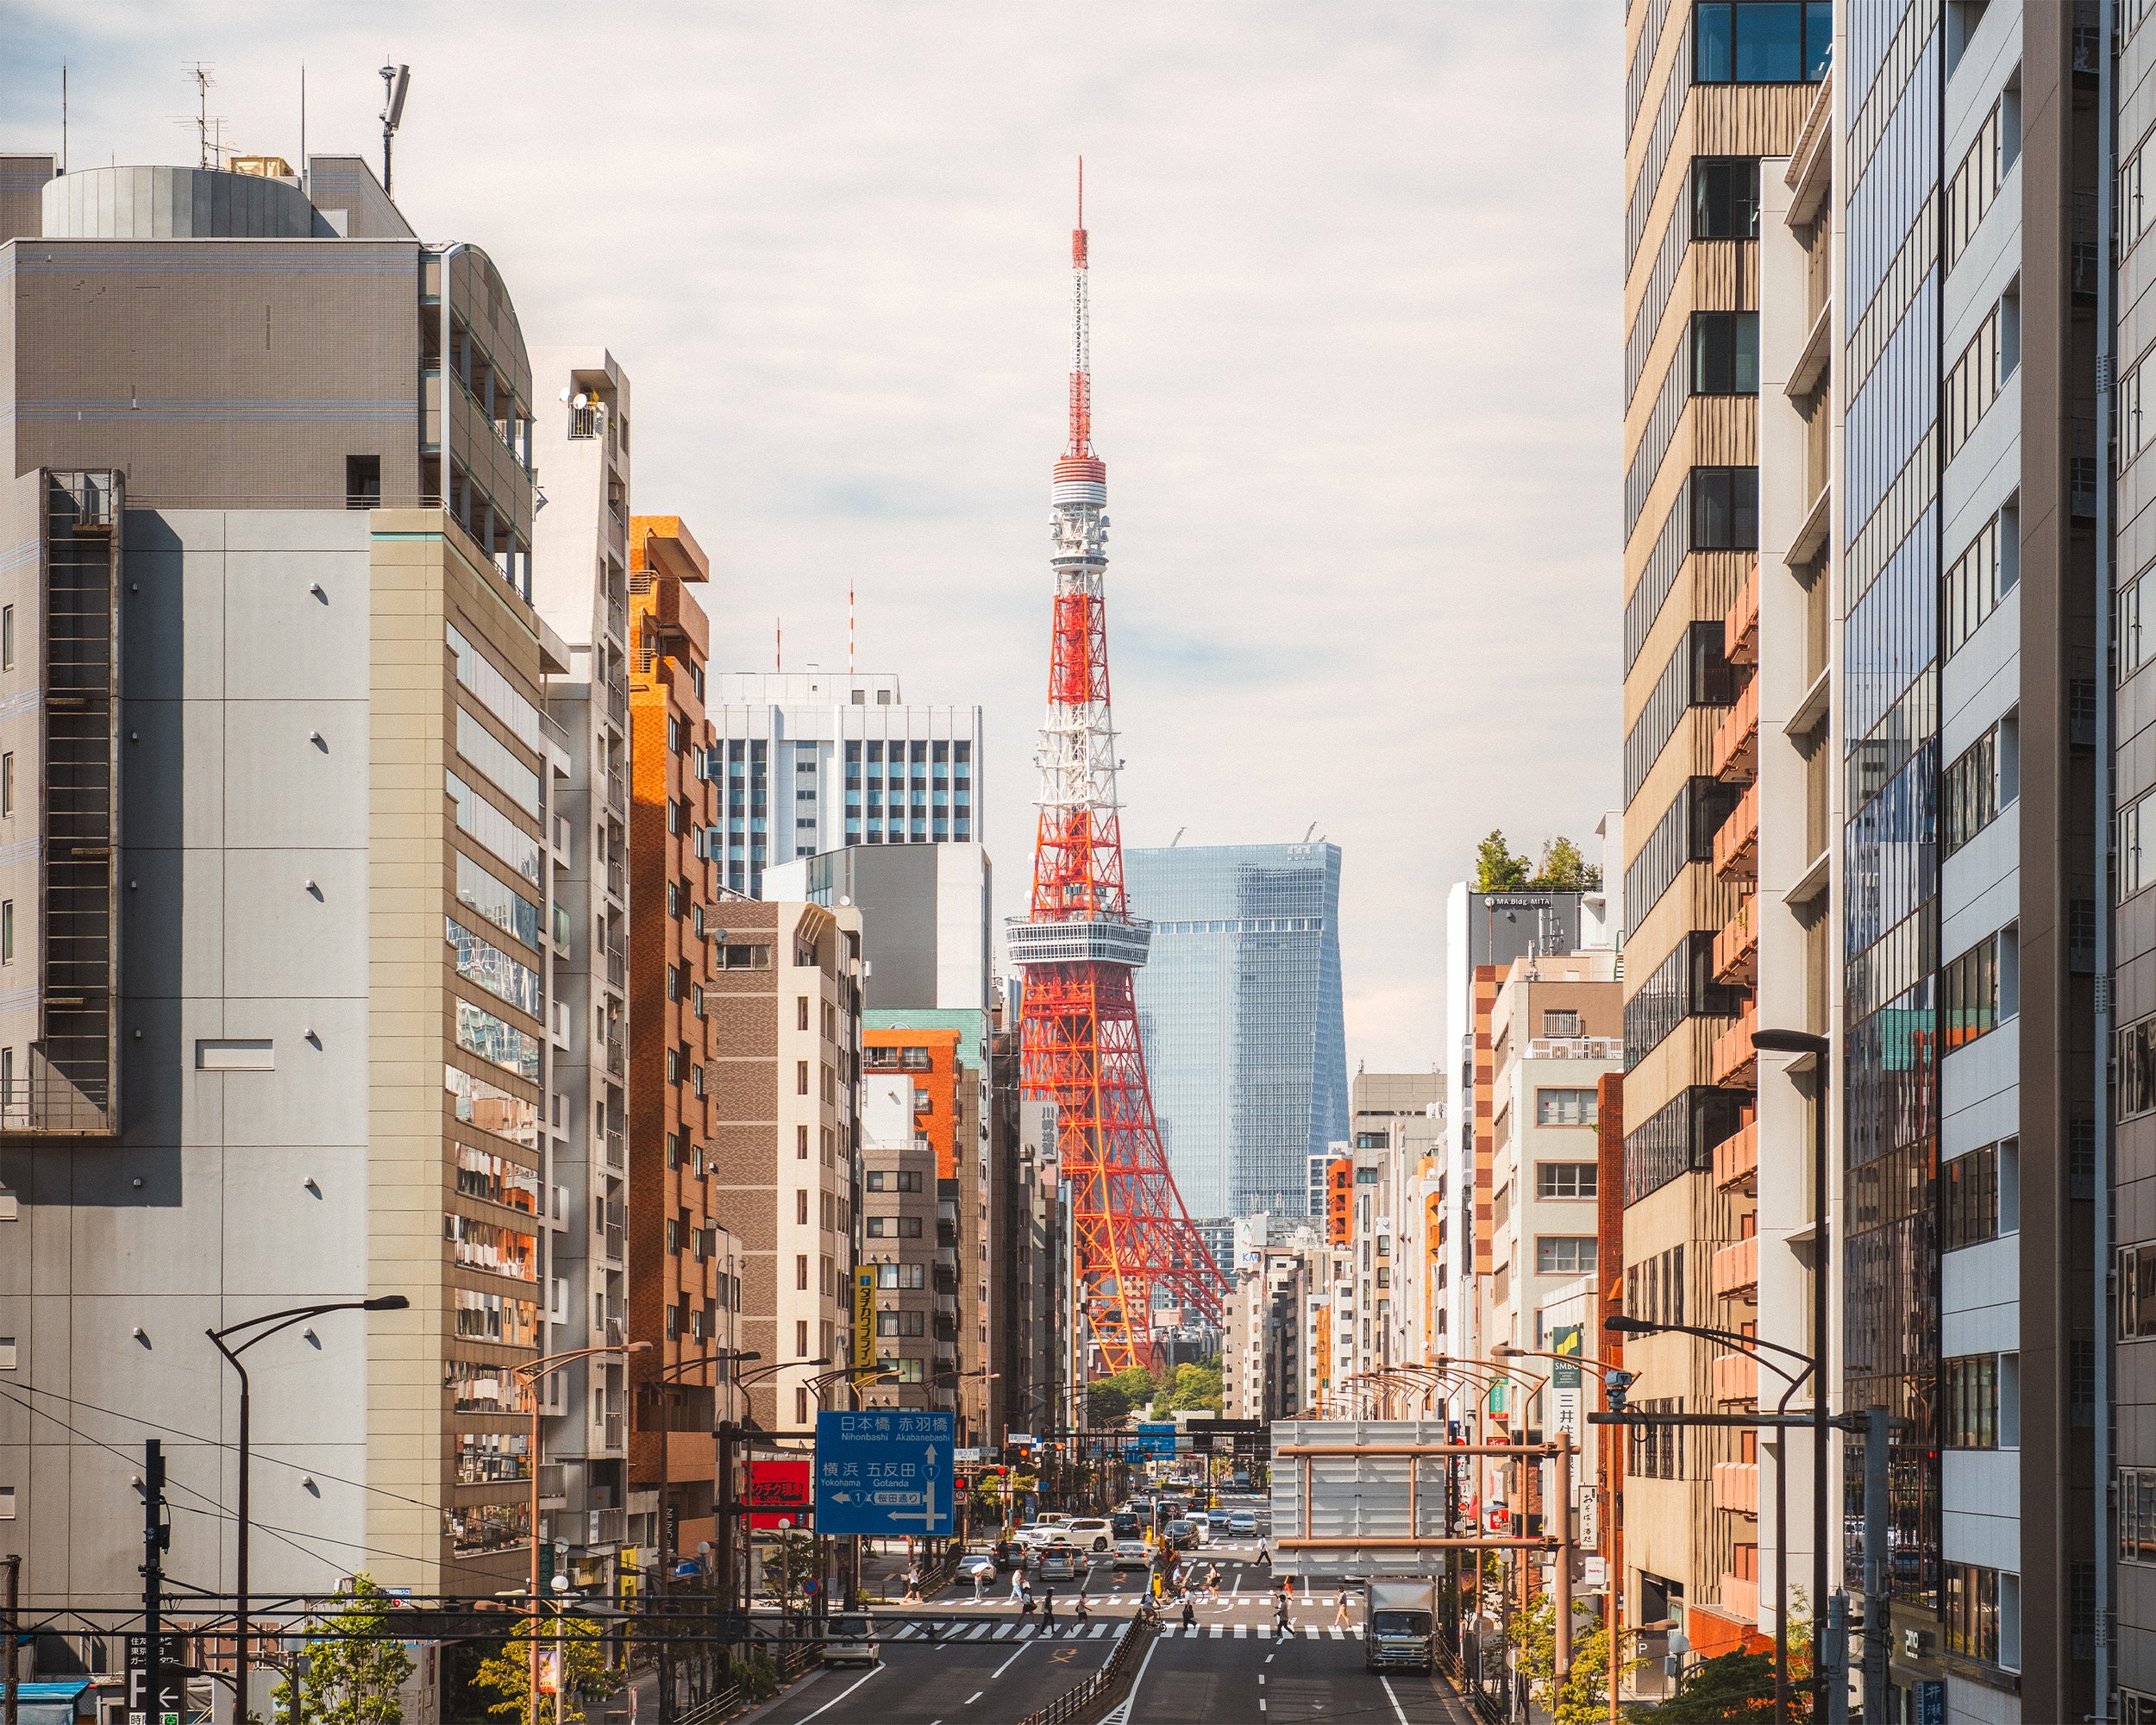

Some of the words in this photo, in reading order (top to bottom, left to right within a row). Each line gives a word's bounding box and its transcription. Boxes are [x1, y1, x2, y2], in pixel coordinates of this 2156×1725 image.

[1511, 898, 1529, 906] Bldg.
[860, 1288, 871, 1377] タチカワブライン
[841, 1416, 890, 1432] 日本橋
[899, 1417, 948, 1432] 赤羽橋
[842, 1433, 888, 1441] Nihonbashi
[823, 1462, 859, 1477] 横浜
[867, 1463, 915, 1477] 五反田
[928, 1467, 933, 1476] 1
[820, 1478, 861, 1487] Yokohama
[874, 1478, 909, 1487] Gotanda
[856, 1493, 861, 1502] 1
[878, 1492, 918, 1503] 桜田通り
[1639, 1643, 1648, 1654] P
[131, 1657, 179, 1665] ガータワー
